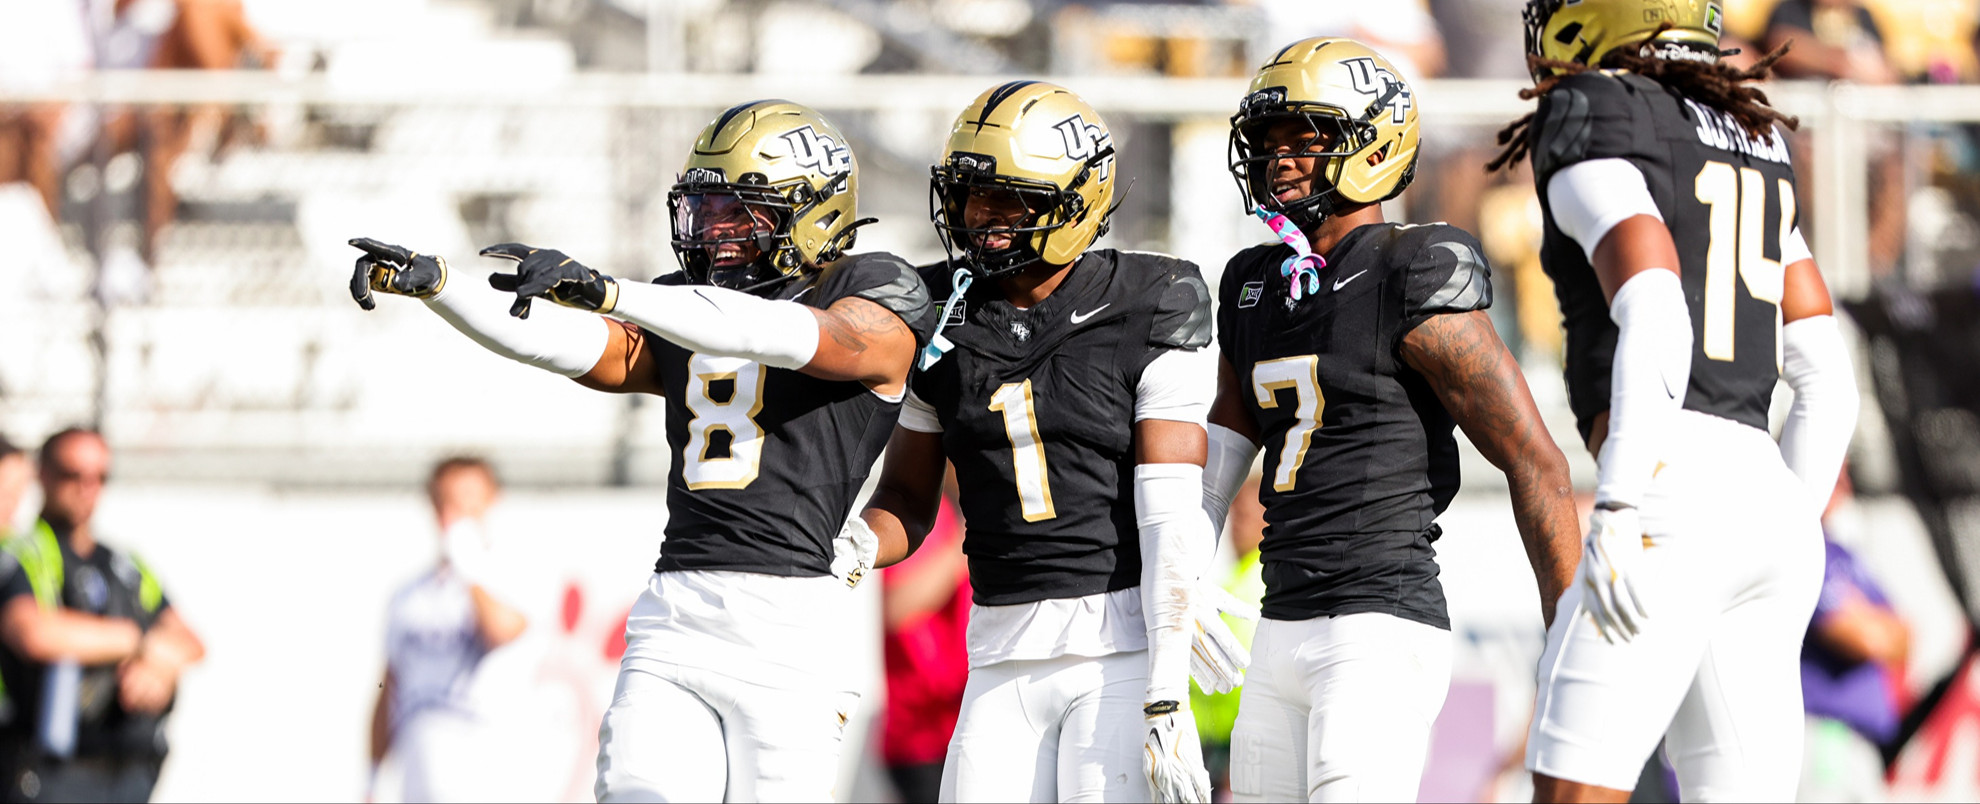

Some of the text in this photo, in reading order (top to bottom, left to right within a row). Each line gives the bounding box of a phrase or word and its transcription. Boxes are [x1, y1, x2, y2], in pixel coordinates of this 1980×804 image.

[778, 124, 851, 194] UCF
[1051, 114, 1113, 183] UCF
[1695, 160, 1796, 377] 14
[682, 351, 767, 491] 8
[988, 377, 1057, 523] 1
[1251, 354, 1326, 492] 7
